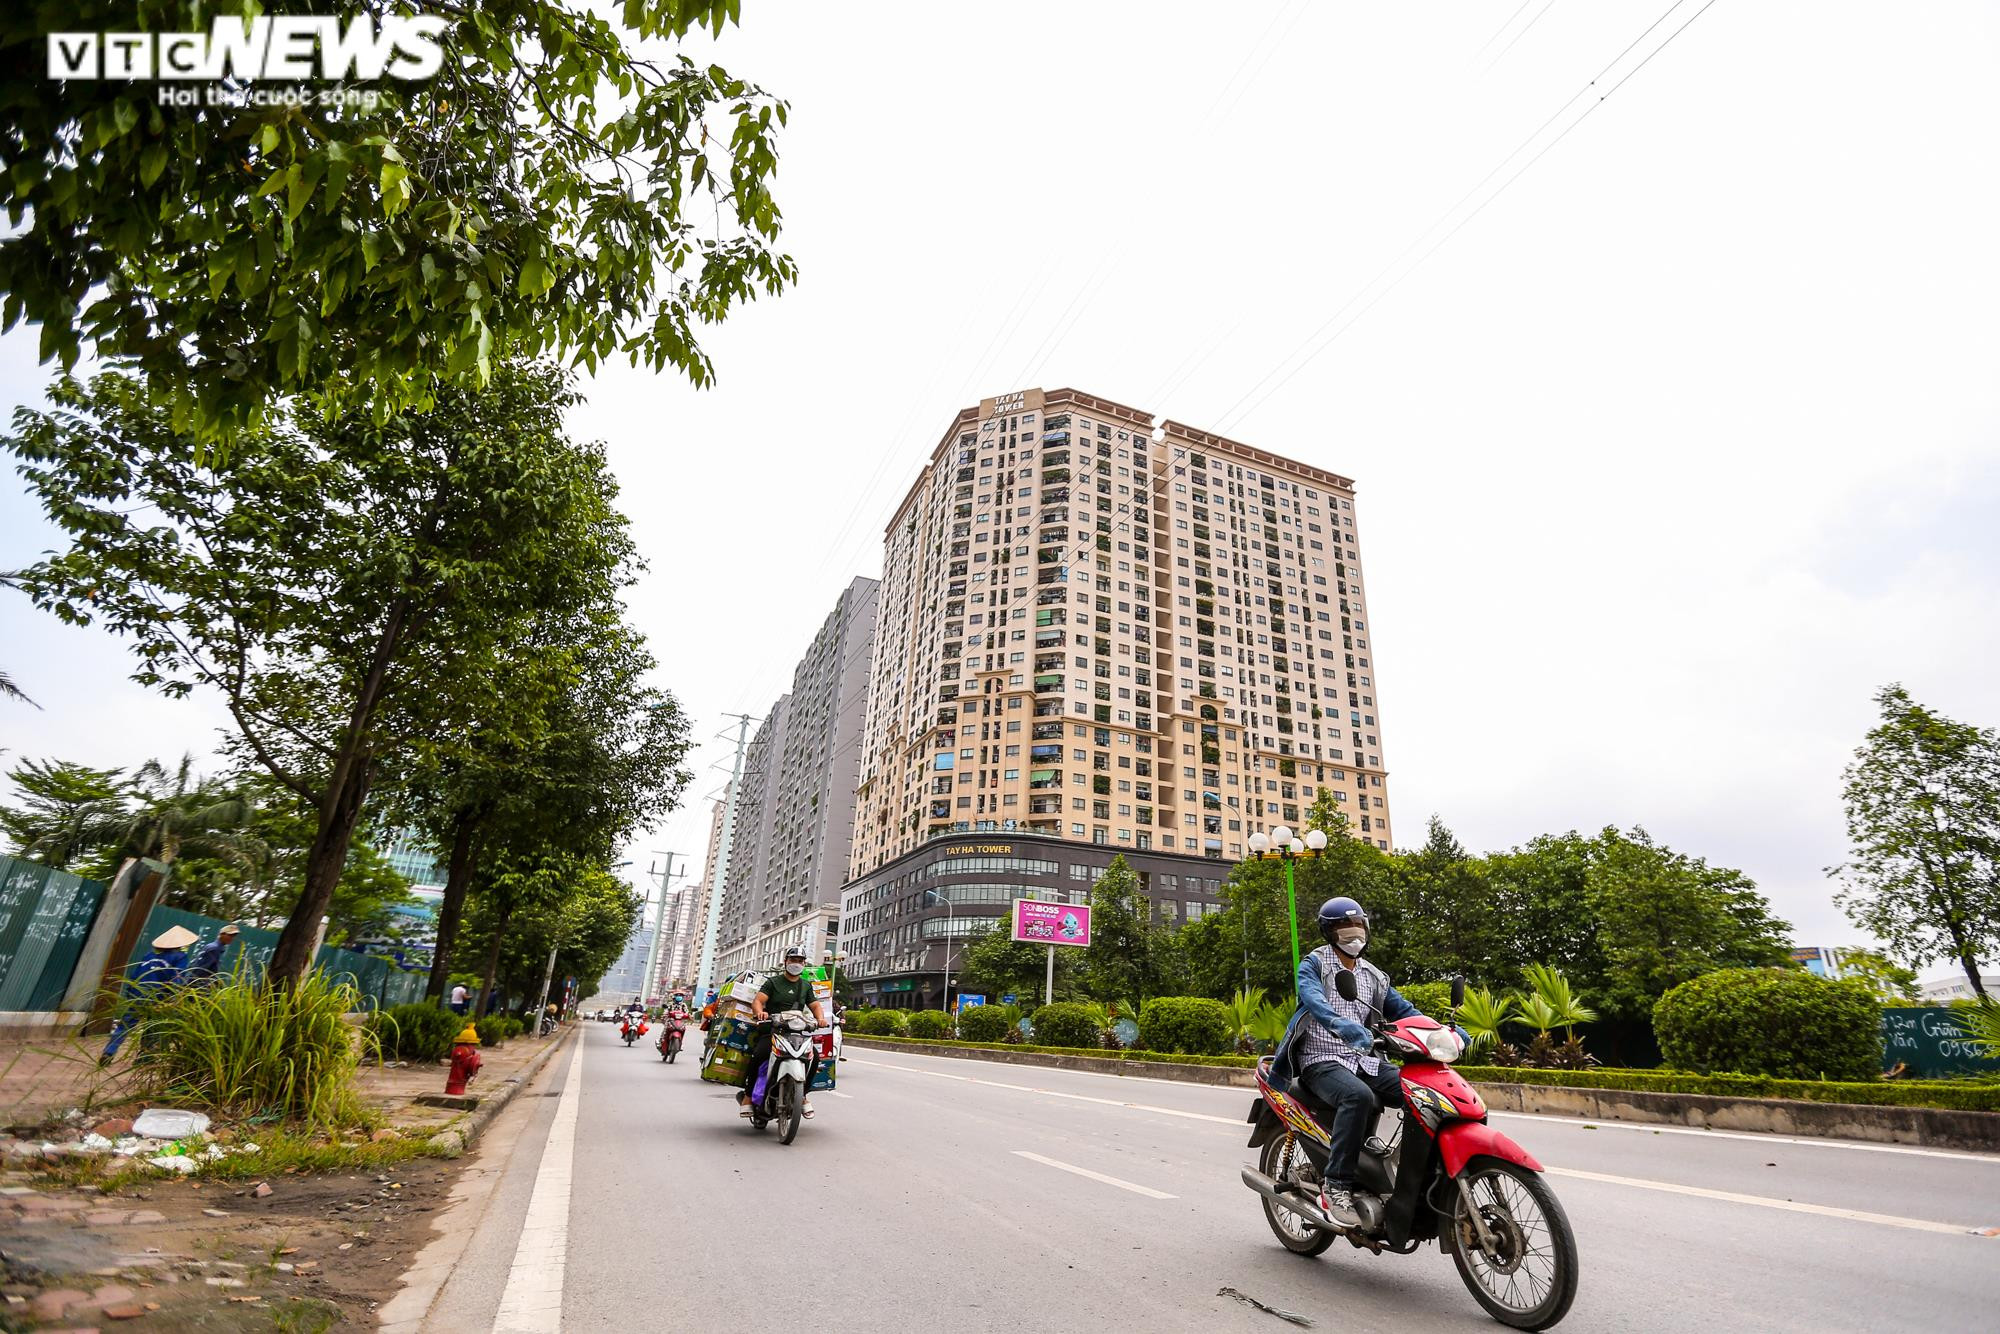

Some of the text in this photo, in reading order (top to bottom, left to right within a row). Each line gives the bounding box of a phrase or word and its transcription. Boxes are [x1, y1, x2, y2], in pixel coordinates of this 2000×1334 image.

[994, 401, 1024, 413] TOWER
[946, 845, 1012, 855] TAY HA TOWER
